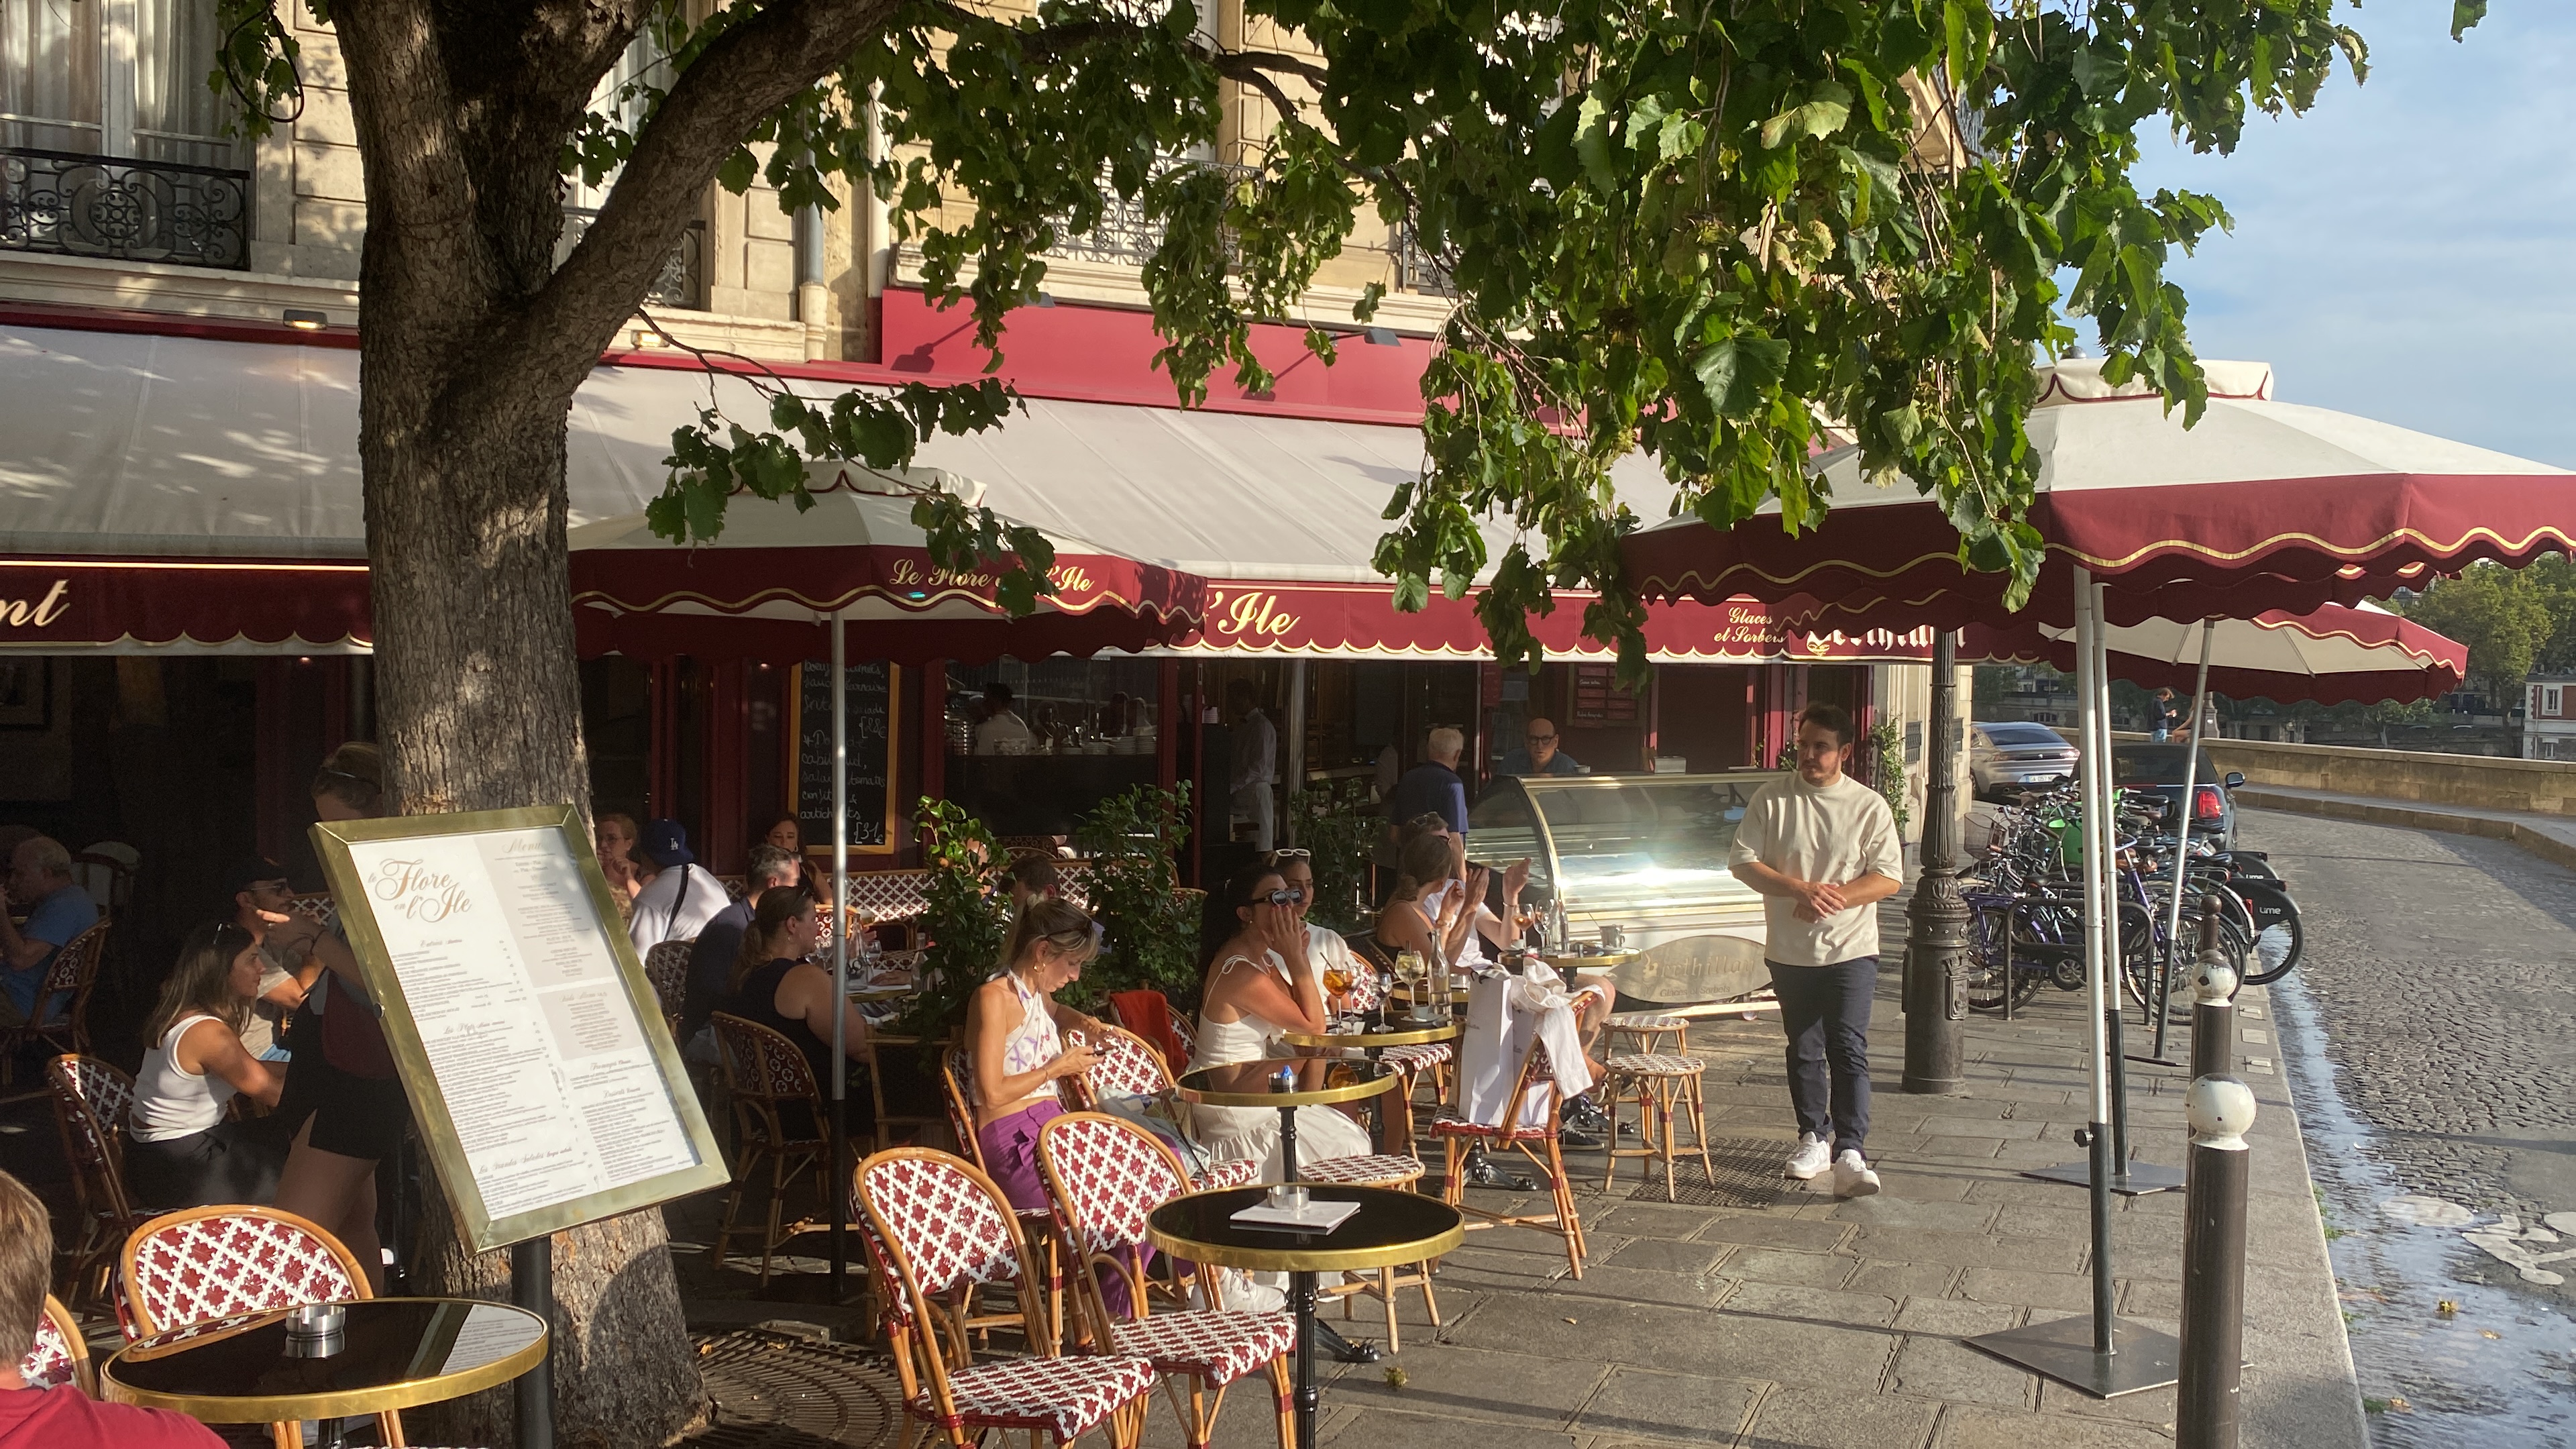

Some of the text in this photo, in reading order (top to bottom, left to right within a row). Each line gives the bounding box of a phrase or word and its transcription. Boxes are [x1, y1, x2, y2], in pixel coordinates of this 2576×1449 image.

[890, 559, 924, 585] Le
[1728, 607, 1773, 625] Glaces
[1714, 627, 1731, 642] et
[502, 839, 542, 853] Menu
[670, 837, 679, 851] LA
[375, 858, 453, 901] Flore
